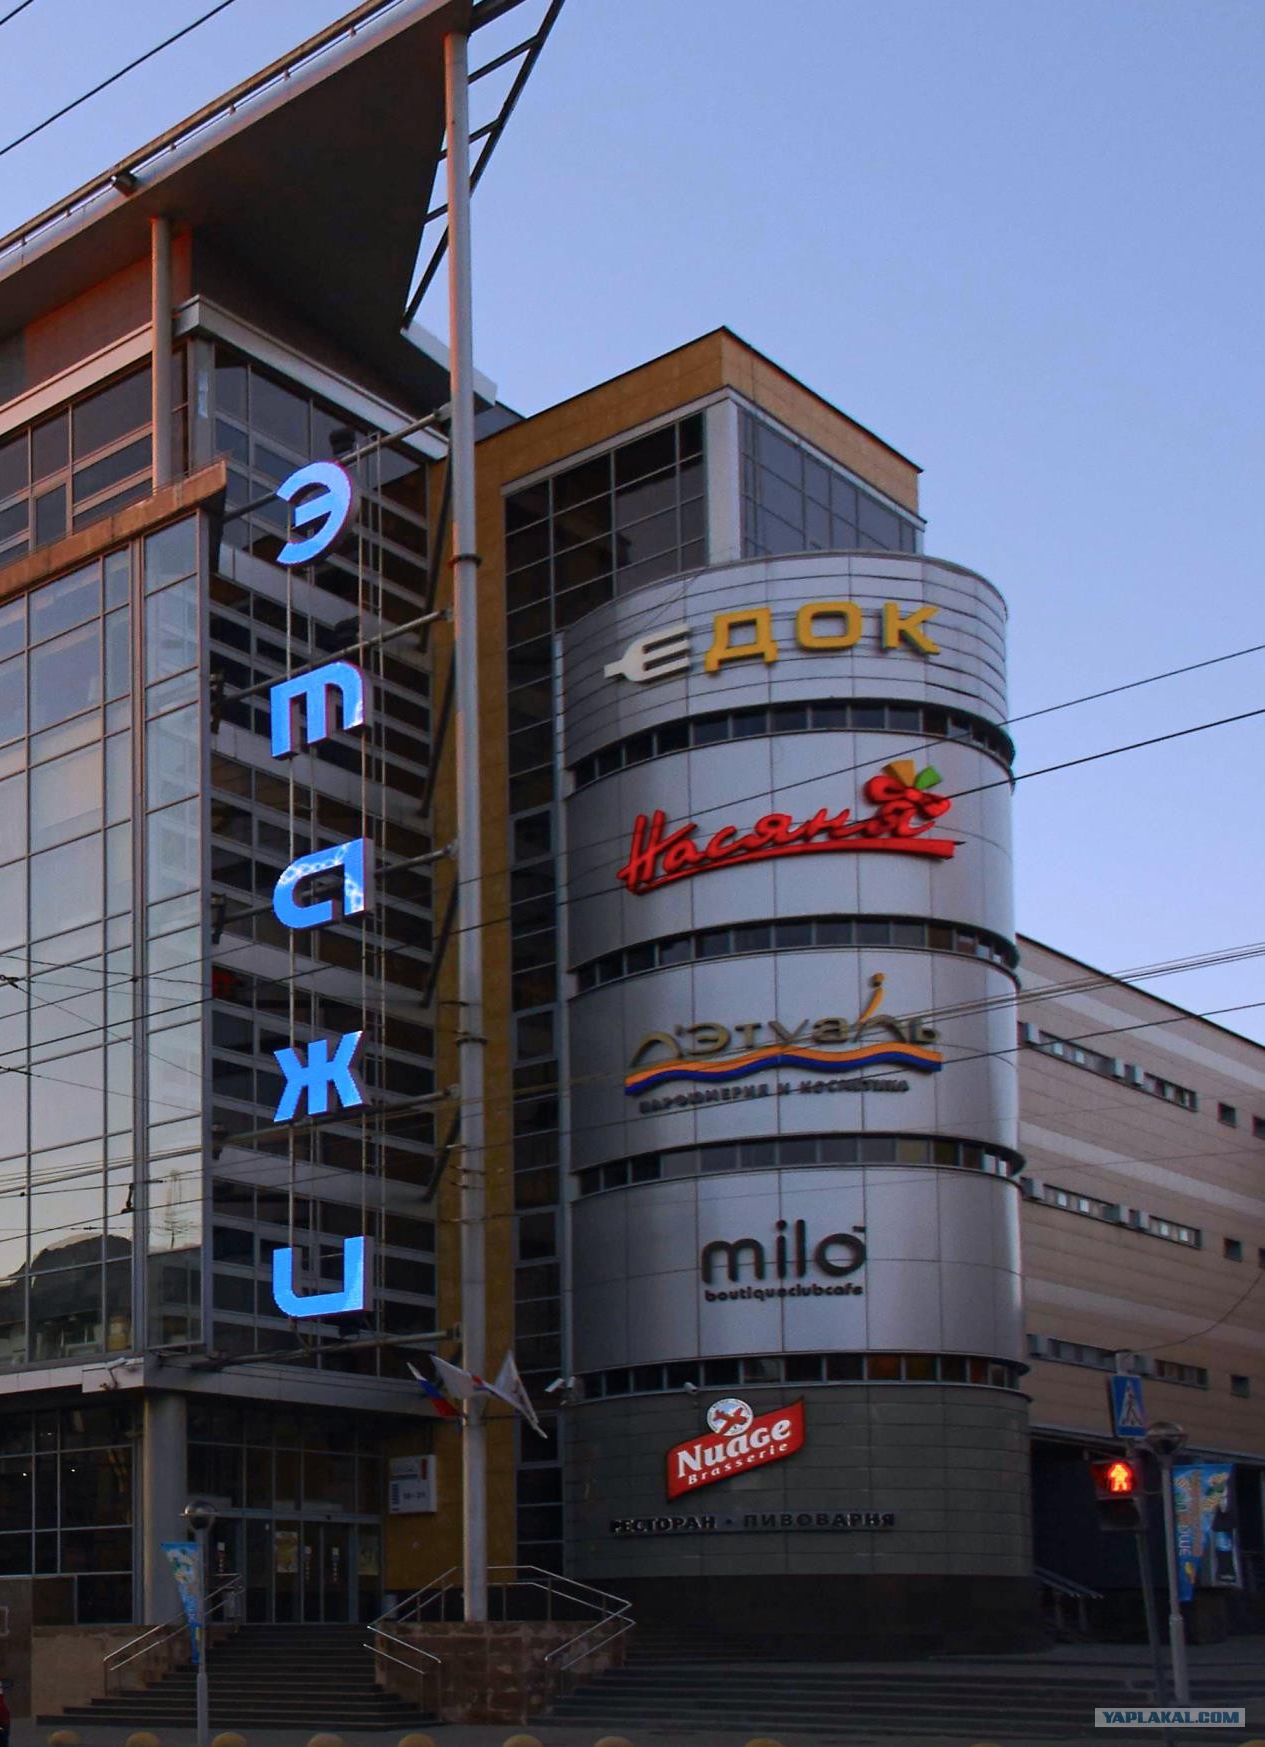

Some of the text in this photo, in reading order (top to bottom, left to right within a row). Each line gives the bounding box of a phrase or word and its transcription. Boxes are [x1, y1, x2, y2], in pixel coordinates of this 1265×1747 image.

[688, 1443, 788, 1485] Brasserie
[610, 1512, 895, 1533] РЕСТОРАН ПИВОВАРНЯ
